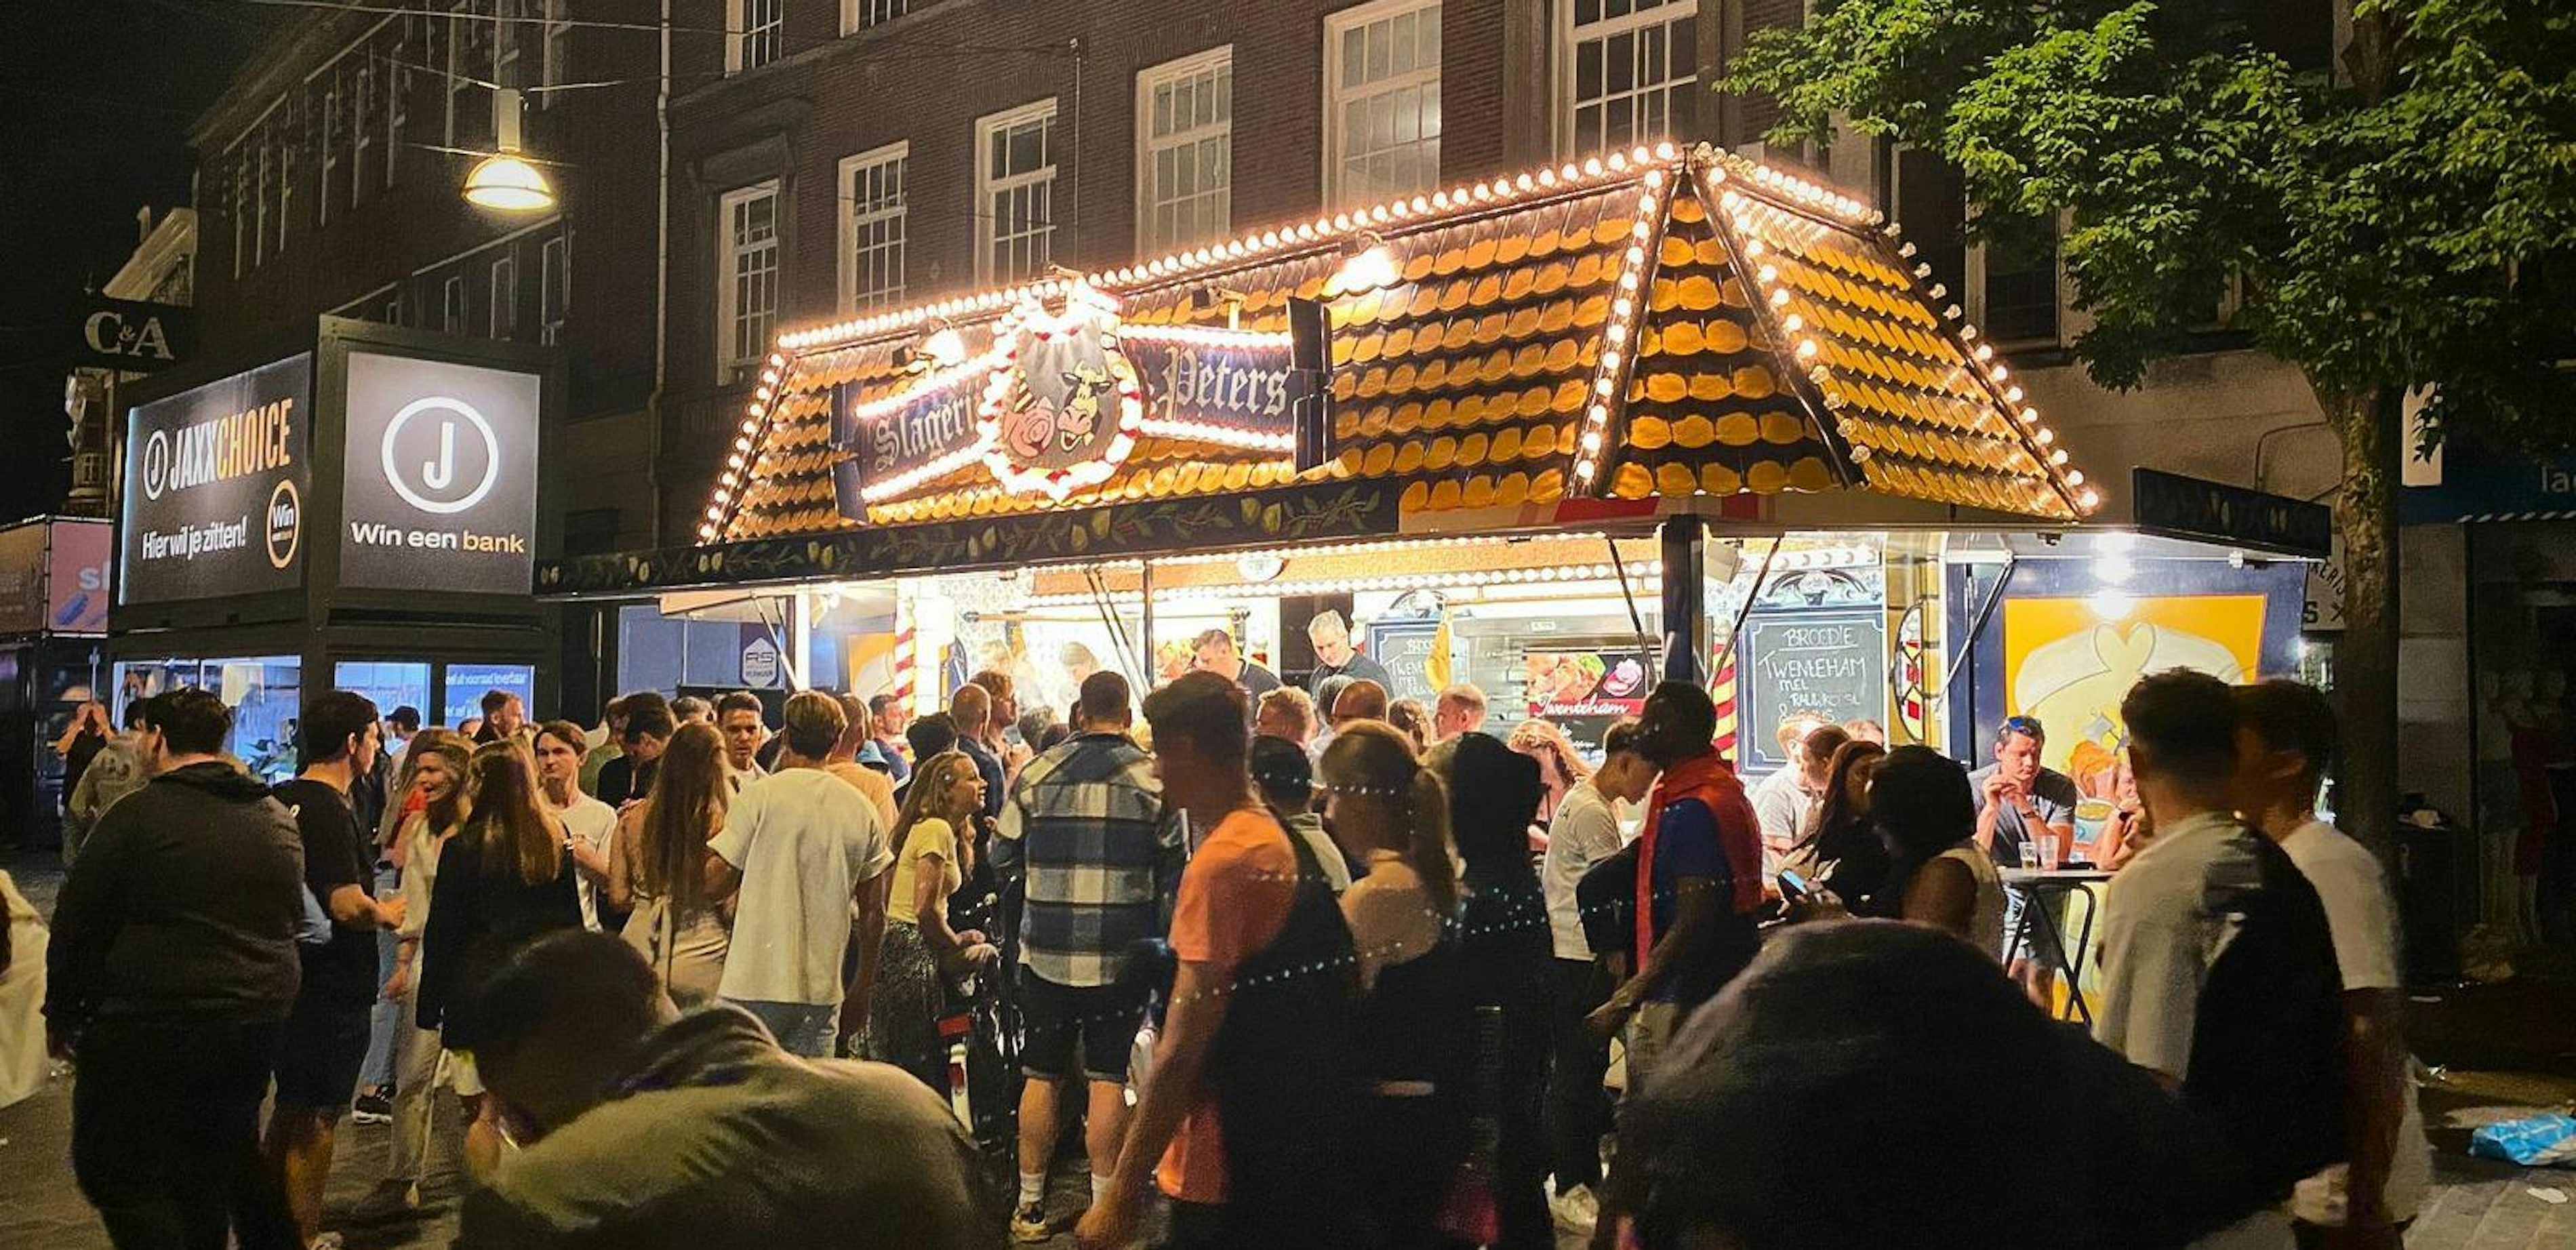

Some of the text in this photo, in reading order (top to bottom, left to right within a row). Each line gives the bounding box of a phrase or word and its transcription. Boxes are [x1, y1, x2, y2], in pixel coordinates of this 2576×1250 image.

[85, 311, 175, 360] C&A
[1157, 346, 1291, 420] Peters
[422, 422, 454, 489] J
[2542, 466, 2576, 493] la
[273, 503, 294, 528] Win
[142, 531, 169, 560] Hier
[169, 525, 188, 556] wil
[187, 525, 203, 561] je
[203, 515, 247, 552] zitten!
[350, 522, 525, 553] Win een bank
[1535, 692, 1630, 717] Twenteham
